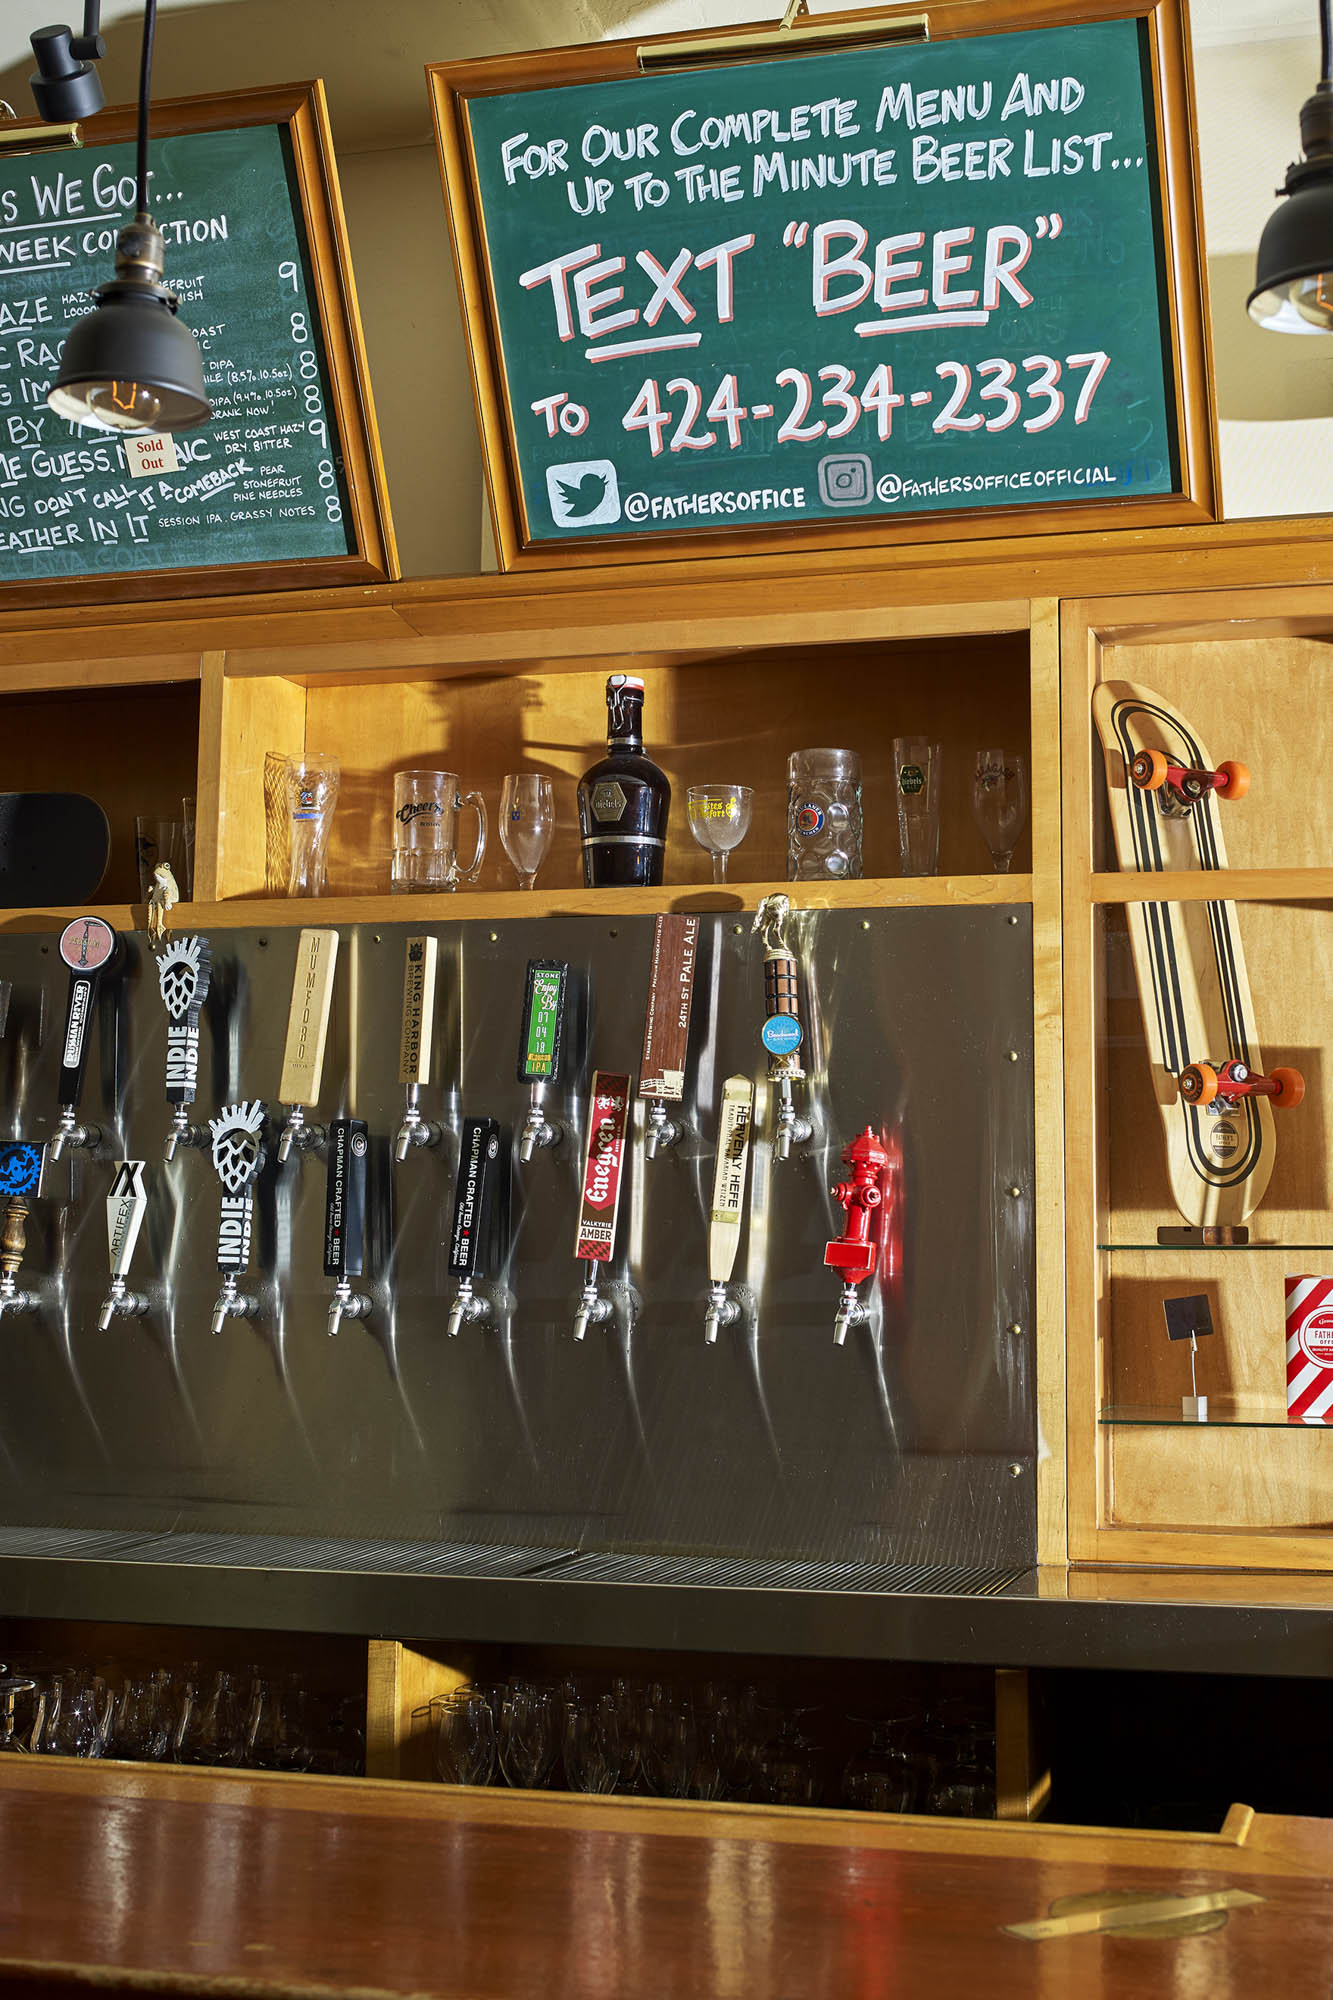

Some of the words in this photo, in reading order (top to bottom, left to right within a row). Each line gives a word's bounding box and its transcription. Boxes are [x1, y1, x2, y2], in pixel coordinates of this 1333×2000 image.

[501, 132, 569, 185] FOR
[581, 123, 660, 167] OUR
[670, 97, 860, 156] COMPLETE
[875, 82, 992, 133] MENU
[1001, 72, 1085, 121] AND
[566, 176, 614, 216] UP
[624, 171, 670, 211] TO
[674, 164, 744, 203] THE
[753, 148, 898, 198] MINUTE
[912, 134, 1014, 184] BEER
[1023, 129, 1144, 178] LIST...
[31, 172, 85, 217] WE
[278, 261, 298, 293] 9
[519, 233, 755, 343] TEXT
[290, 312, 308, 343] 8
[209, 359, 235, 371] DIPA
[300, 350, 318, 379] 8
[304, 384, 321, 414] 8
[530, 391, 590, 438] TO
[621, 351, 1112, 457] 424-234-2337
[6, 415, 45, 444] BY
[214, 429, 241, 442] WEST
[245, 425, 277, 439] COAST
[280, 421, 305, 435] HAZY
[253, 437, 293, 452] BITTER
[308, 418, 327, 449] 9
[136, 439, 165, 453] Sold
[32, 448, 116, 478] GUESS.
[142, 457, 164, 471] Out
[260, 464, 286, 476] PEAR
[318, 459, 334, 489] 8
[34, 487, 87, 515] DON'T
[93, 484, 138, 509] CALL
[138, 485, 154, 506] IT
[158, 480, 173, 496] A
[174, 457, 254, 504] COMEBACK
[233, 492, 256, 502] PINE
[258, 487, 303, 500] NEEDLES
[243, 476, 302, 489] STONEFRUIT
[158, 515, 201, 528] SESSION
[230, 508, 273, 521] GRASSY
[279, 505, 316, 518] NOTES
[325, 495, 342, 523] 8
[624, 487, 806, 522] @FATHERSOFFICE
[88, 517, 119, 542] IN
[126, 512, 149, 537] IT
[685, 918, 696, 945] ALE
[679, 949, 693, 983] PALE
[405, 964, 415, 1017] BREWING
[412, 963, 424, 1003] KING
[534, 979, 558, 996] Enjoy
[680, 987, 690, 1001] ST
[541, 993, 558, 1011] By
[678, 1003, 688, 1029] 24TH
[66, 1023, 80, 1062] RUSSIAN
[73, 984, 86, 1021] RIVER
[402, 1018, 412, 1075] COMPANY
[408, 1007, 421, 1075] HARBOR
[166, 1026, 188, 1088] INDIE
[185, 1027, 200, 1089] INDIE
[532, 1061, 546, 1073] IPA
[334, 1127, 345, 1178] CHAPMAN
[468, 1127, 482, 1178] CHAPMAN
[730, 1105, 748, 1171] HEAVENLY
[586, 1117, 619, 1203] Enegren
[333, 1179, 344, 1228] CRAFTED
[463, 1179, 476, 1228] CRAFTED
[728, 1175, 741, 1209] HEFE
[110, 1199, 131, 1257] ARTIFEX
[217, 1196, 245, 1264] INDIE
[241, 1197, 254, 1265] INDIE
[580, 1228, 613, 1242] AMBER
[582, 1219, 613, 1229] VALKYRIE
[331, 1237, 341, 1266] BEER
[458, 1237, 470, 1266] BEER
